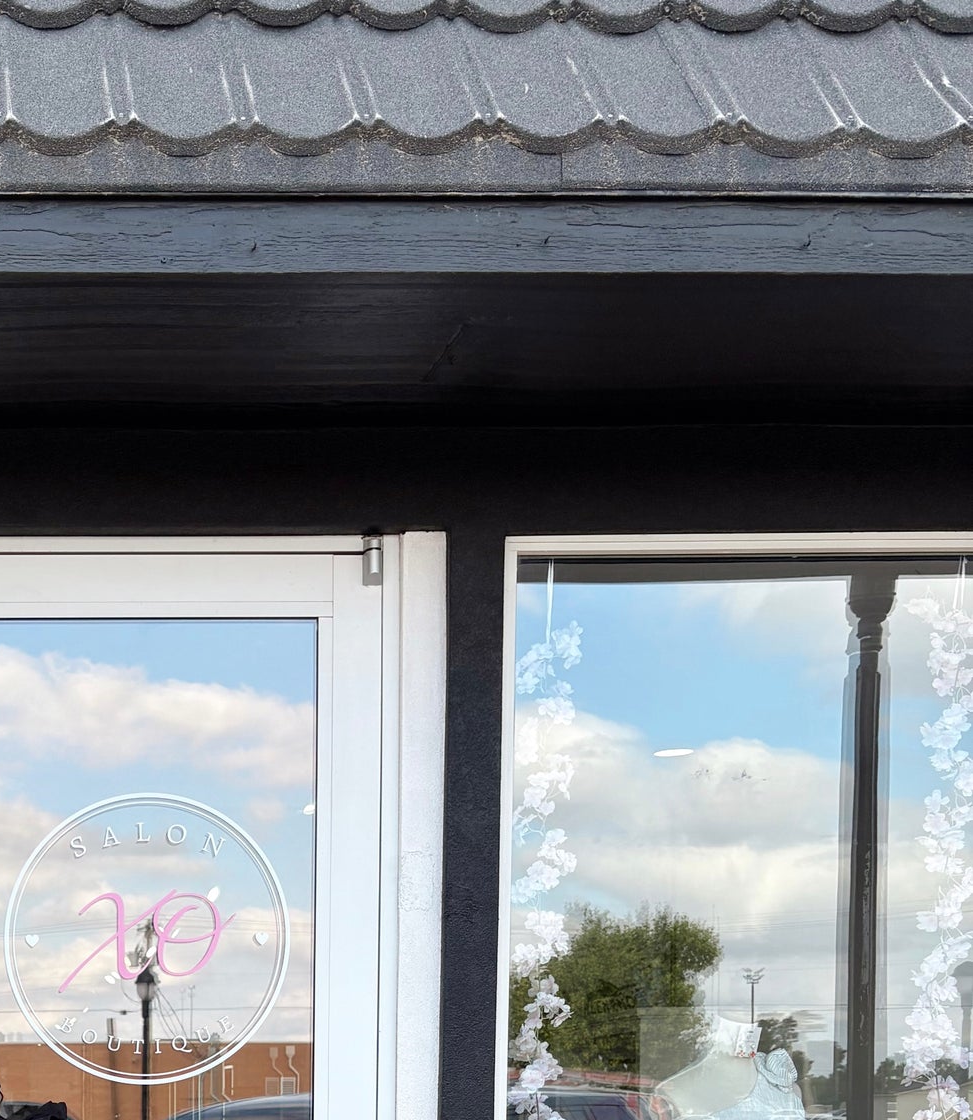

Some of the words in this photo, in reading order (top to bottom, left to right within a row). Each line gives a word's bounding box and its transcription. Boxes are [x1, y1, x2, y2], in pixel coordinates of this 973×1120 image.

[69, 822, 226, 858] SALON
[58, 889, 236, 993] XO
[59, 1015, 235, 1054] BOUTIQUE
